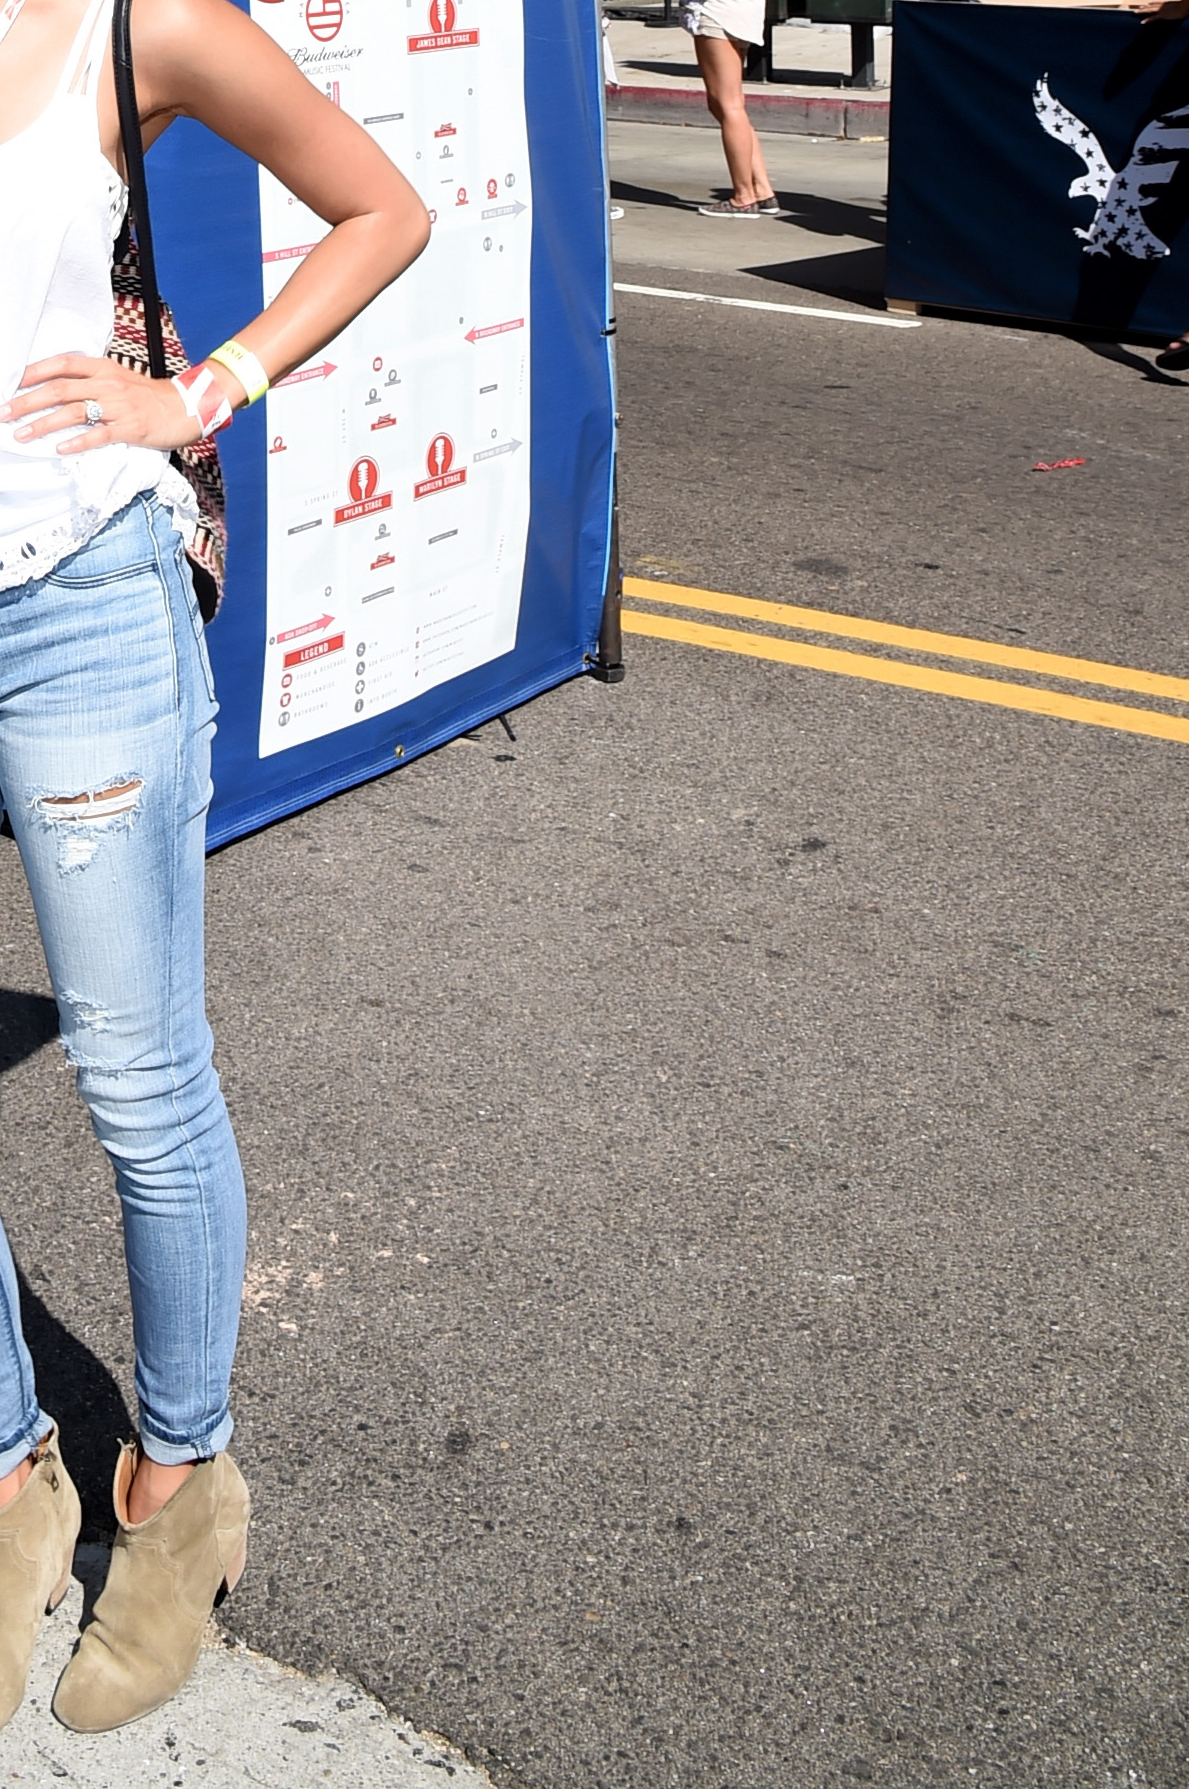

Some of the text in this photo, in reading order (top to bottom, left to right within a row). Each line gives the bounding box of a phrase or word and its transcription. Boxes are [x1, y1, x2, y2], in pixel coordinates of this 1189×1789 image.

[416, 37, 436, 49] JAMES
[452, 33, 471, 45] STAGE
[287, 44, 364, 67] Budweiser
[418, 472, 461, 494] MARILYN STAGE
[343, 498, 383, 519] DYLAN STAGE
[300, 642, 329, 661] LEGEND
